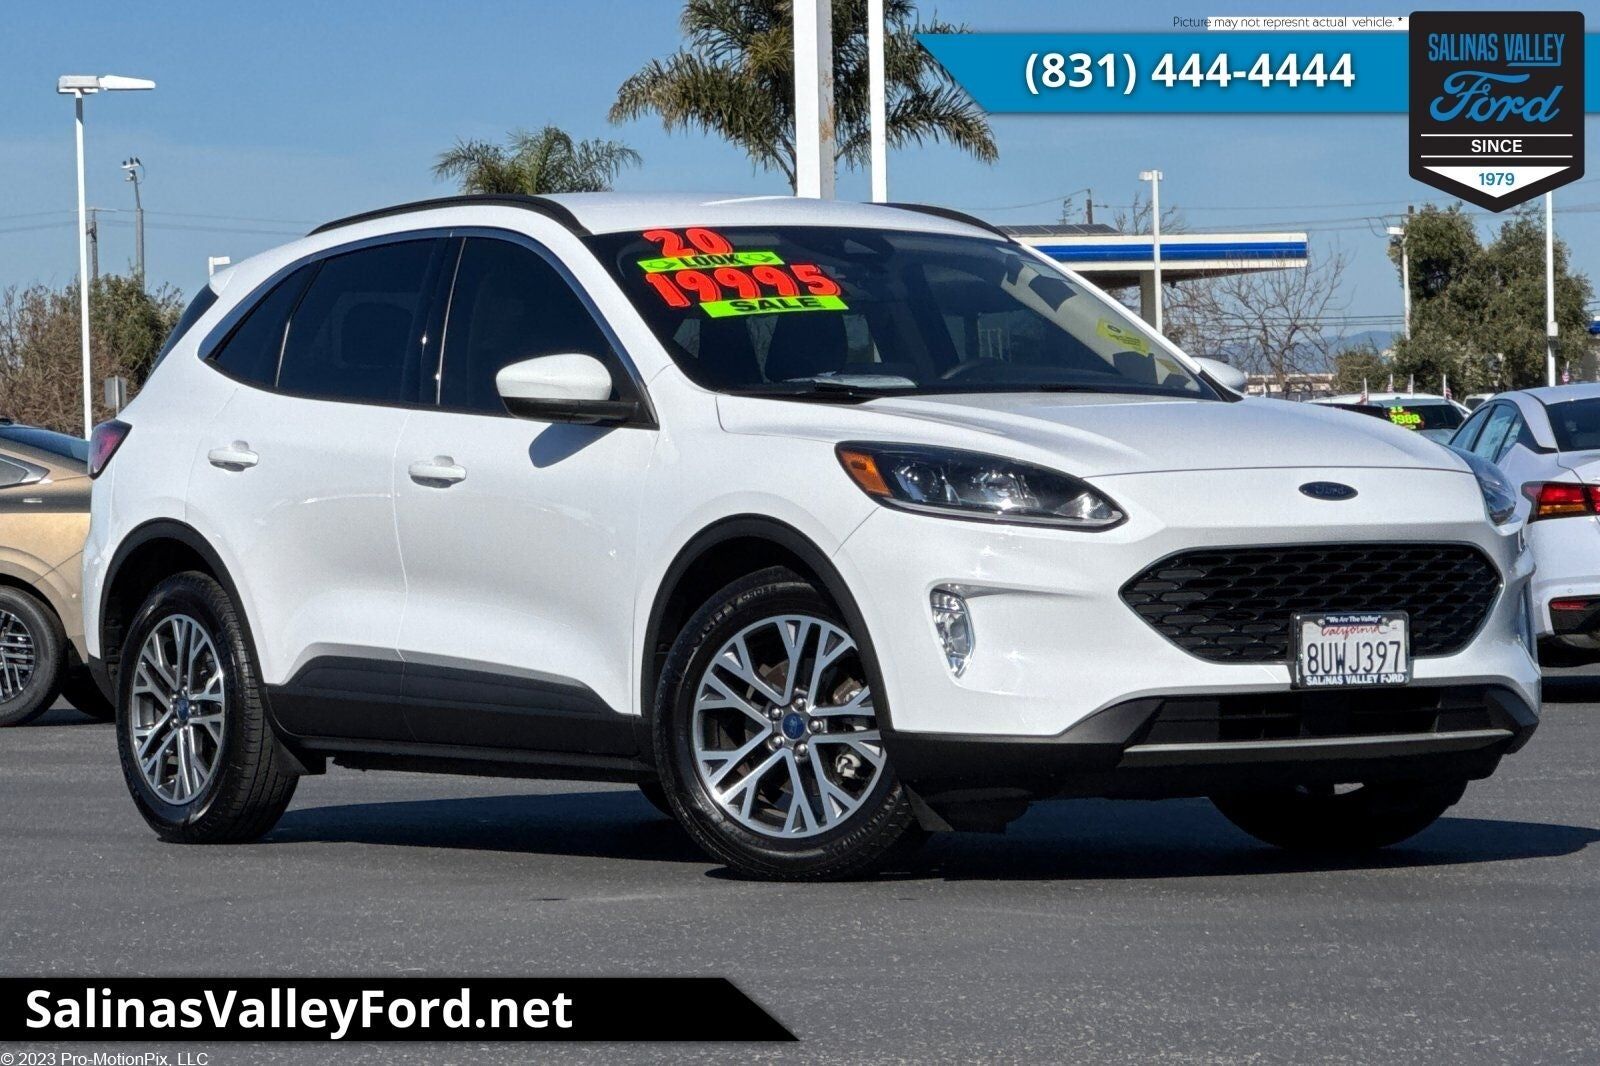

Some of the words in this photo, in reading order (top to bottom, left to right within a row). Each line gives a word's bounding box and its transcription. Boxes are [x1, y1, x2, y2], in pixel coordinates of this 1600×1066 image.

[643, 228, 733, 257] 20
[681, 254, 740, 267] LOOK
[645, 264, 841, 307] 19995
[730, 298, 822, 312] SALE
[1321, 624, 1387, 640] California
[1307, 641, 1401, 674] 8UWJ397
[1306, 675, 1343, 686] SALINAS
[1345, 674, 1378, 685] VALLEY
[1380, 673, 1404, 684] FORD
